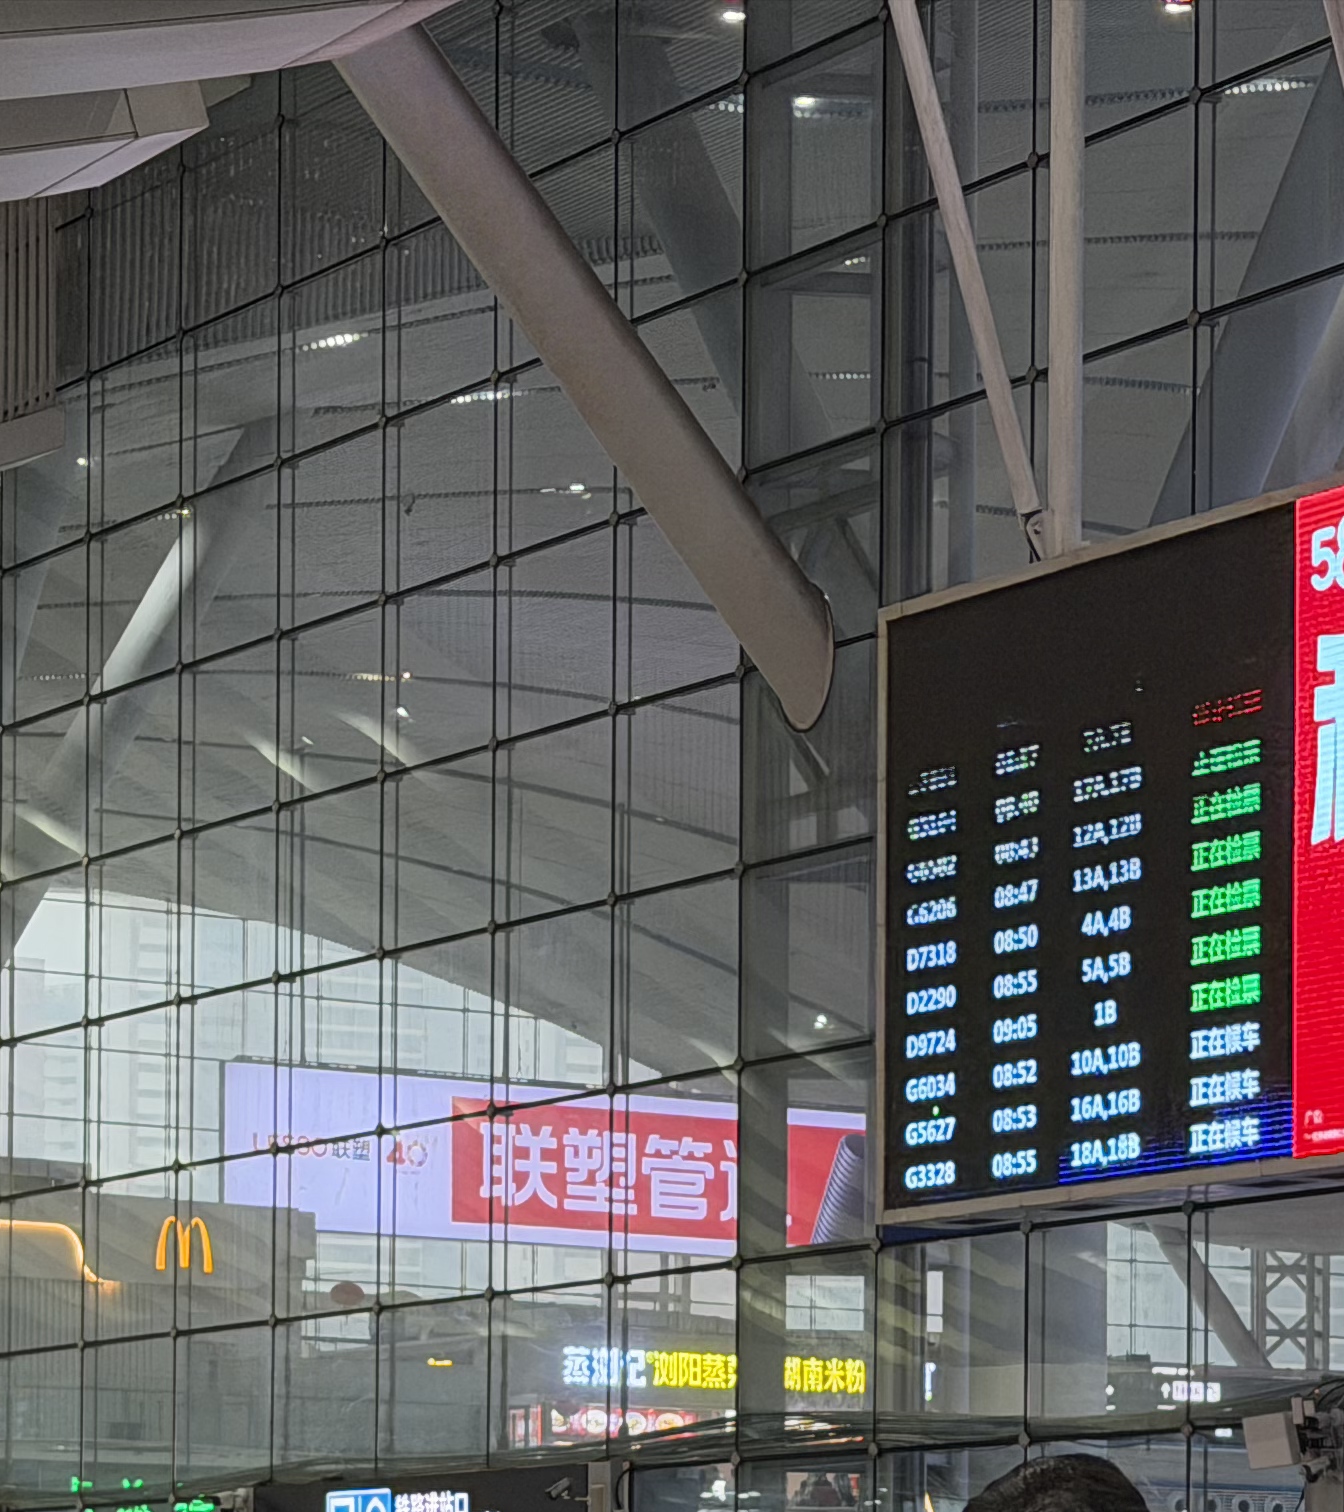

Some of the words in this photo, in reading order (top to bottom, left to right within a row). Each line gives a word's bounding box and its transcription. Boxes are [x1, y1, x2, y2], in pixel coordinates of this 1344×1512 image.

[1073, 857, 1142, 893] 13A,13B
[1081, 905, 1132, 937] 4A,4B
[993, 924, 1038, 954] 08:50
[906, 940, 957, 972] D7318
[1081, 951, 1132, 984] 5A,5B
[906, 984, 957, 1016] D2290
[993, 969, 1038, 999] 08:55
[993, 1013, 1038, 1044] 09:05
[1093, 998, 1118, 1027] 1B
[906, 1028, 957, 1060] D9724
[1071, 1041, 1142, 1077] 10A,10B
[905, 1072, 956, 1104] G6034
[992, 1058, 1038, 1090] 08:52
[992, 1103, 1037, 1134] 08:53
[1070, 1087, 1142, 1123] 16A,16B
[905, 1116, 956, 1147] G5627
[992, 1148, 1037, 1179] 08:55
[1070, 1131, 1142, 1169] 18A,18B
[905, 1160, 956, 1191] G3328
